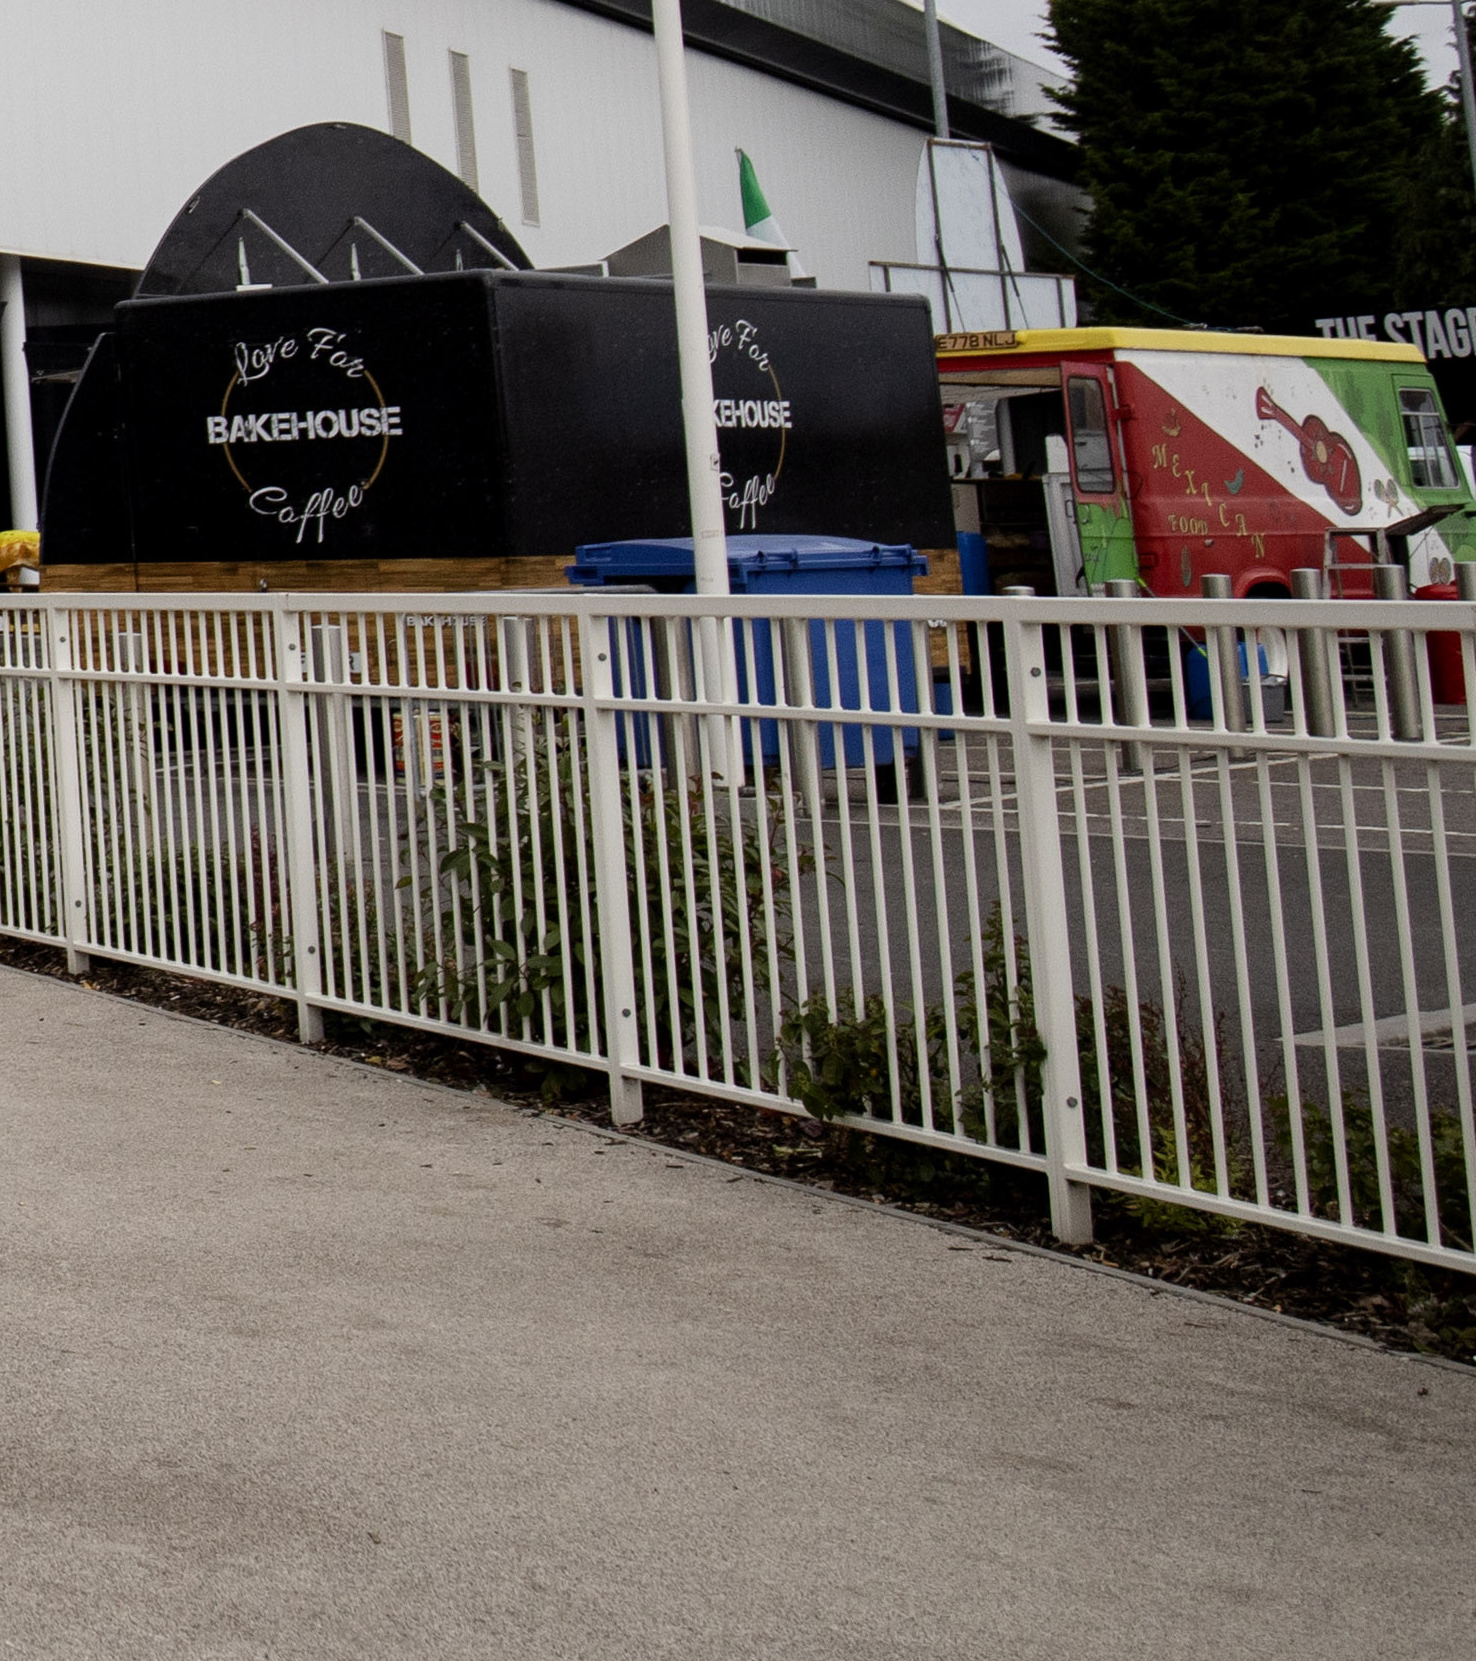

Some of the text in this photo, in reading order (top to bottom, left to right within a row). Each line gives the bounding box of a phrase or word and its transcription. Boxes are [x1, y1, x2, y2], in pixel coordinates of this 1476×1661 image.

[234, 327, 365, 387] Love For
[735, 319, 771, 372] For
[938, 334, 980, 349] E778
[206, 406, 404, 444] BAKEHOUSE
[713, 399, 793, 429] KEHOUSE
[249, 483, 365, 544] Coffee
[1168, 514, 1209, 536] FOOD
